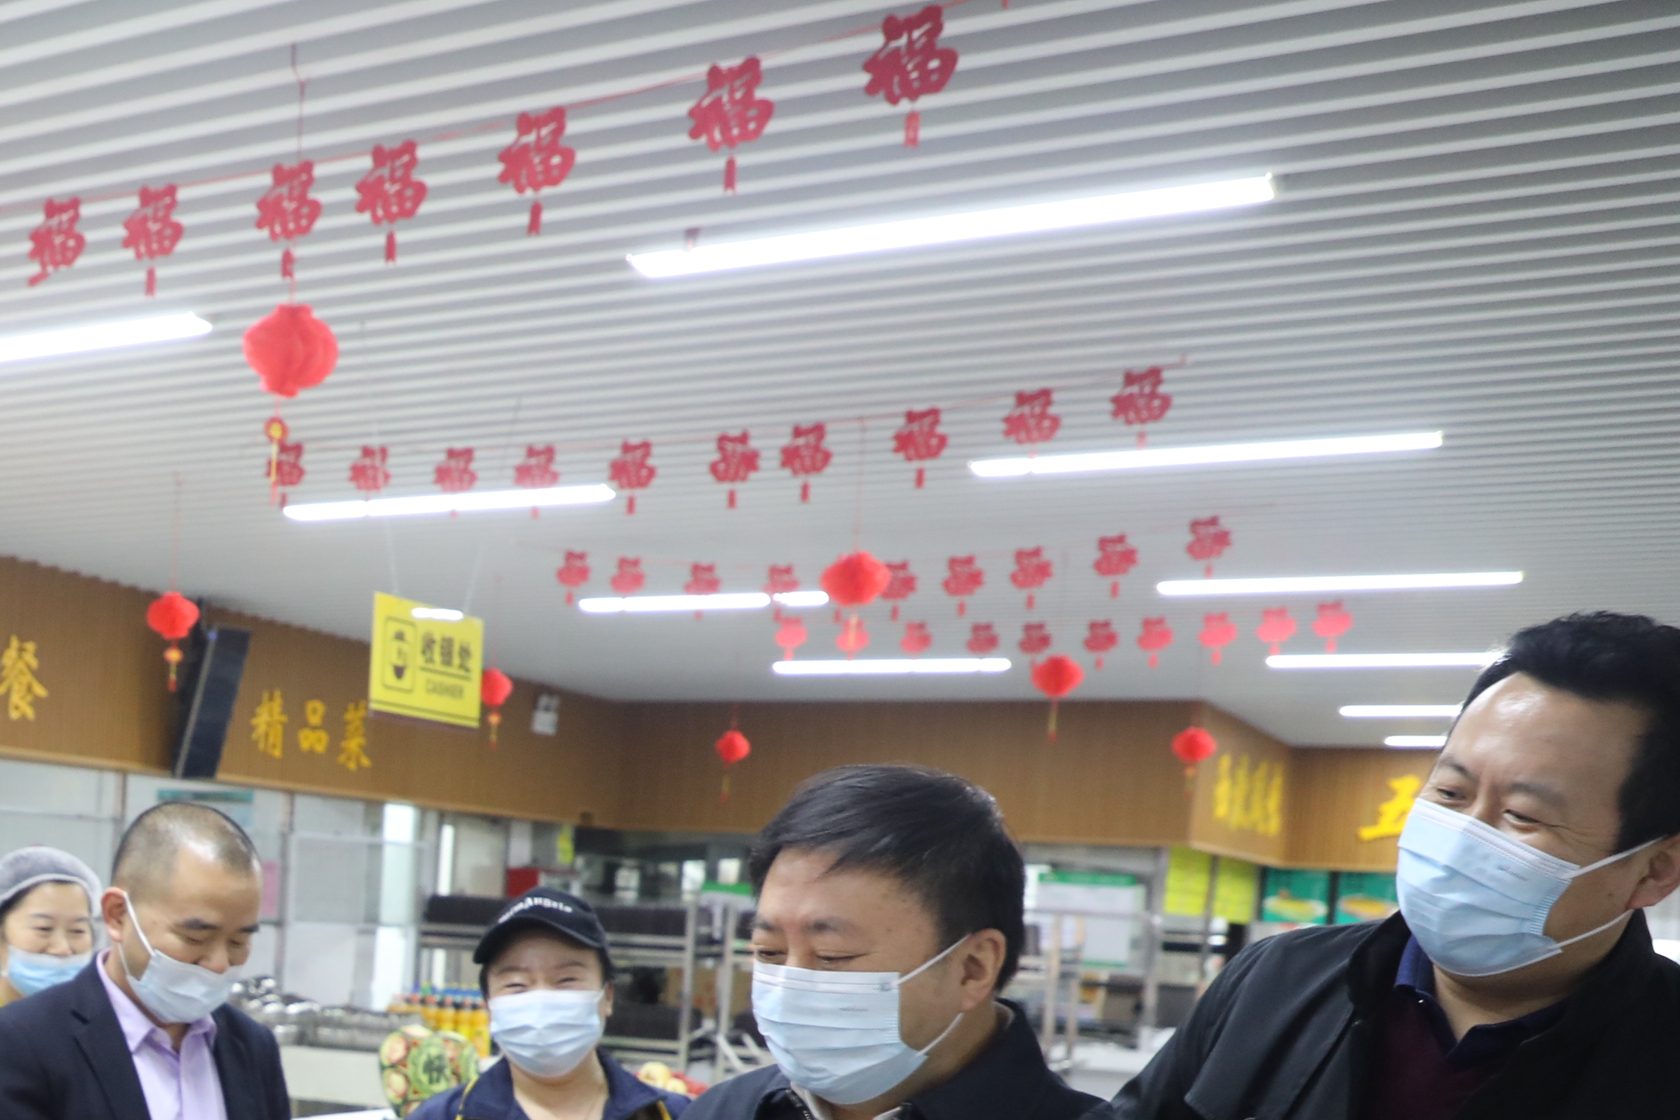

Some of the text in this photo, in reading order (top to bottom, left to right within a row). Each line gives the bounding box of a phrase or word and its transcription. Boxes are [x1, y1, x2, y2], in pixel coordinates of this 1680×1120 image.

[862, 5, 958, 105] 福
[687, 56, 774, 151] 福
[355, 140, 427, 225] 福
[498, 107, 575, 194] 福
[255, 161, 321, 241] 福
[250, 690, 372, 770] 精品菜
